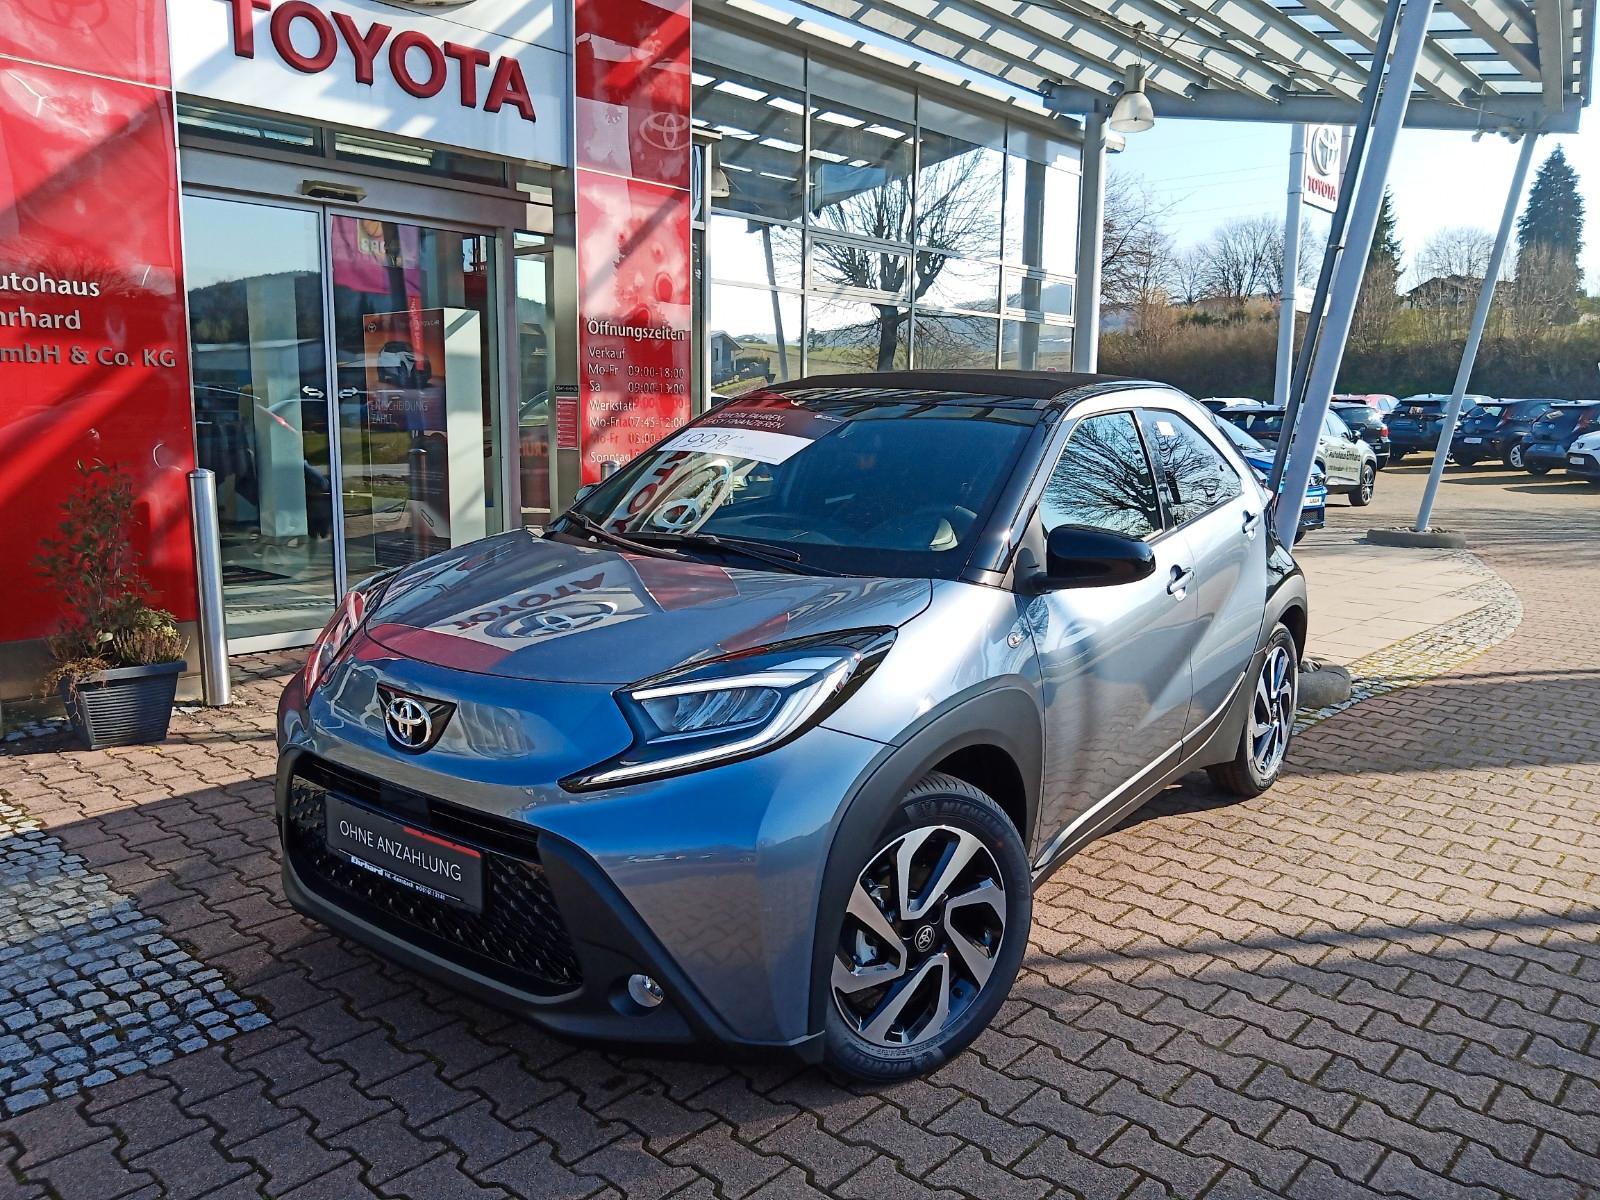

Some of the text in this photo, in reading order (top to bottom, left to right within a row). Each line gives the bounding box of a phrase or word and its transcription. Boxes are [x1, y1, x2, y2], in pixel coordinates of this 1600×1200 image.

[226, 0, 537, 122] TOYOTA
[1306, 175, 1337, 201] TOYOTA
[588, 317, 686, 342] Öffnungszeiten
[70, 345, 90, 365] &
[97, 347, 135, 366] Co.
[144, 348, 176, 367] KG
[588, 346, 627, 360] Verkauf
[588, 362, 619, 376] Mo-Fr
[589, 380, 601, 392] Sa
[589, 399, 637, 412] Werkstatt
[339, 821, 462, 882] OHNE ANZAHLUNG
